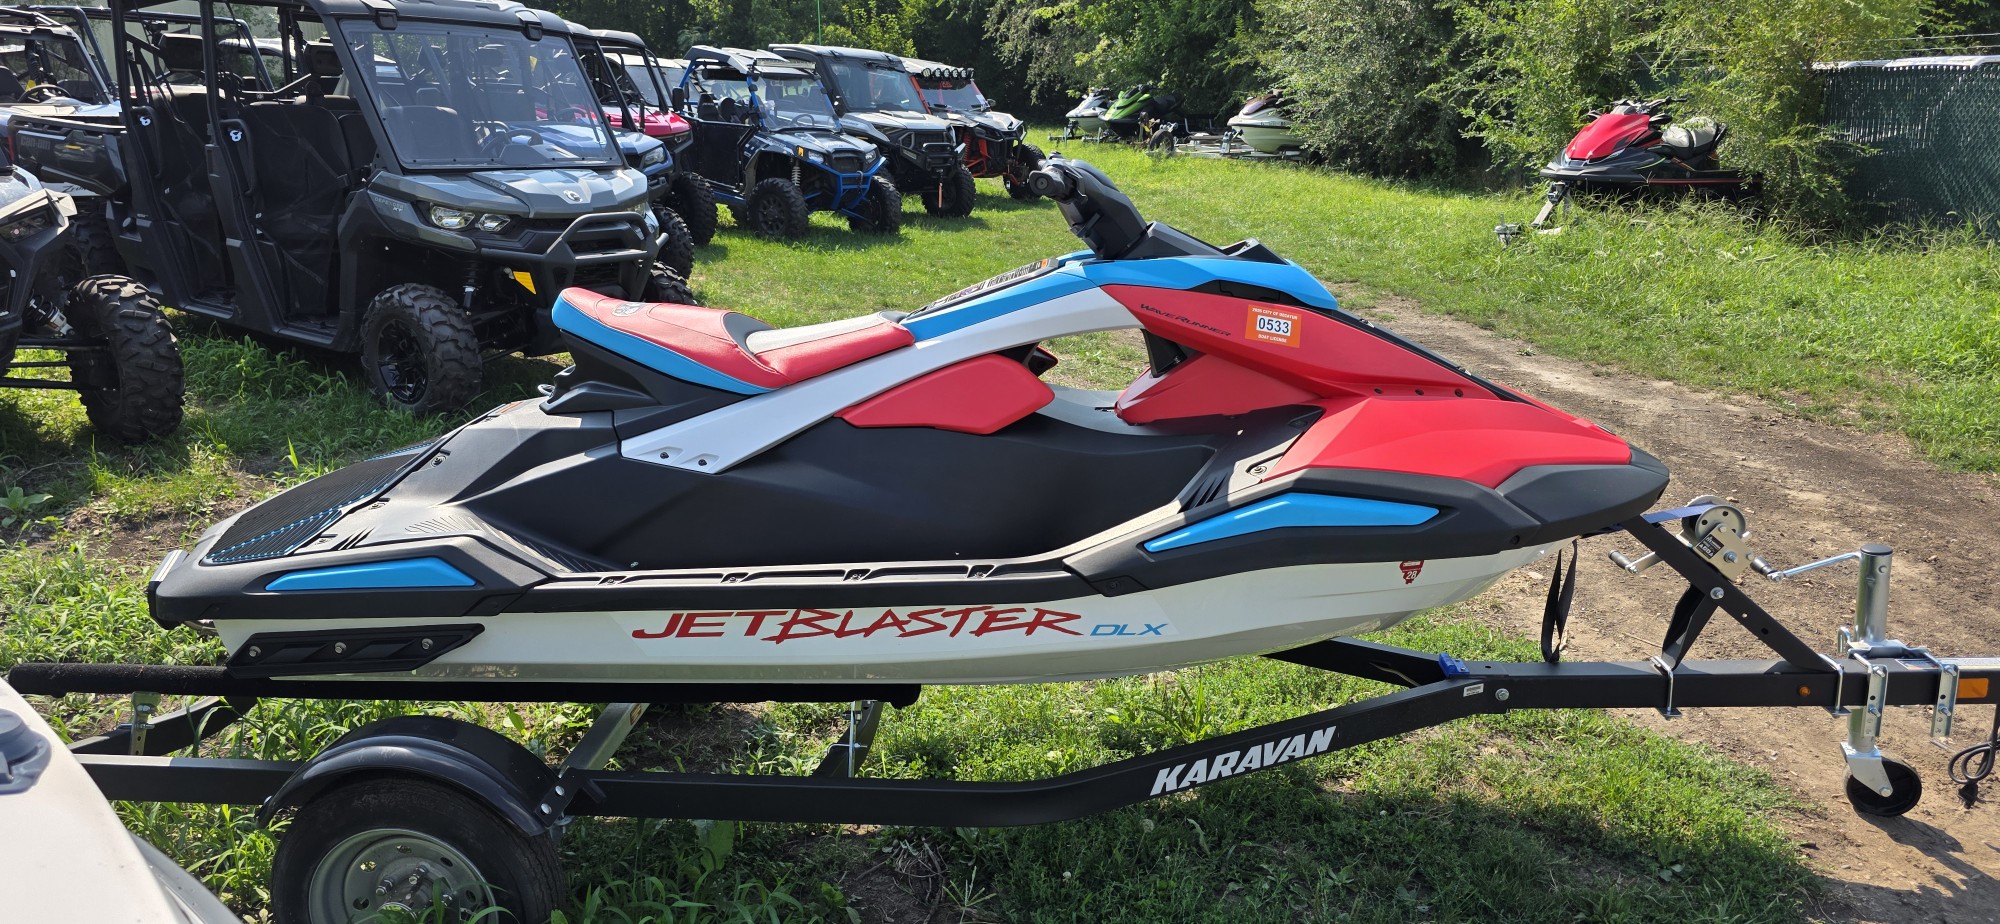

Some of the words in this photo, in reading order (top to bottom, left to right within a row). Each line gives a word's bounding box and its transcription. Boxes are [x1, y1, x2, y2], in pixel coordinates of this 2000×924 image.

[1258, 317, 1290, 334] 0533
[1269, 335, 1288, 343] LICENSE
[1405, 570, 1418, 580] 28
[1089, 623, 1168, 637] DLX
[1149, 725, 1337, 797] KARAVAN
